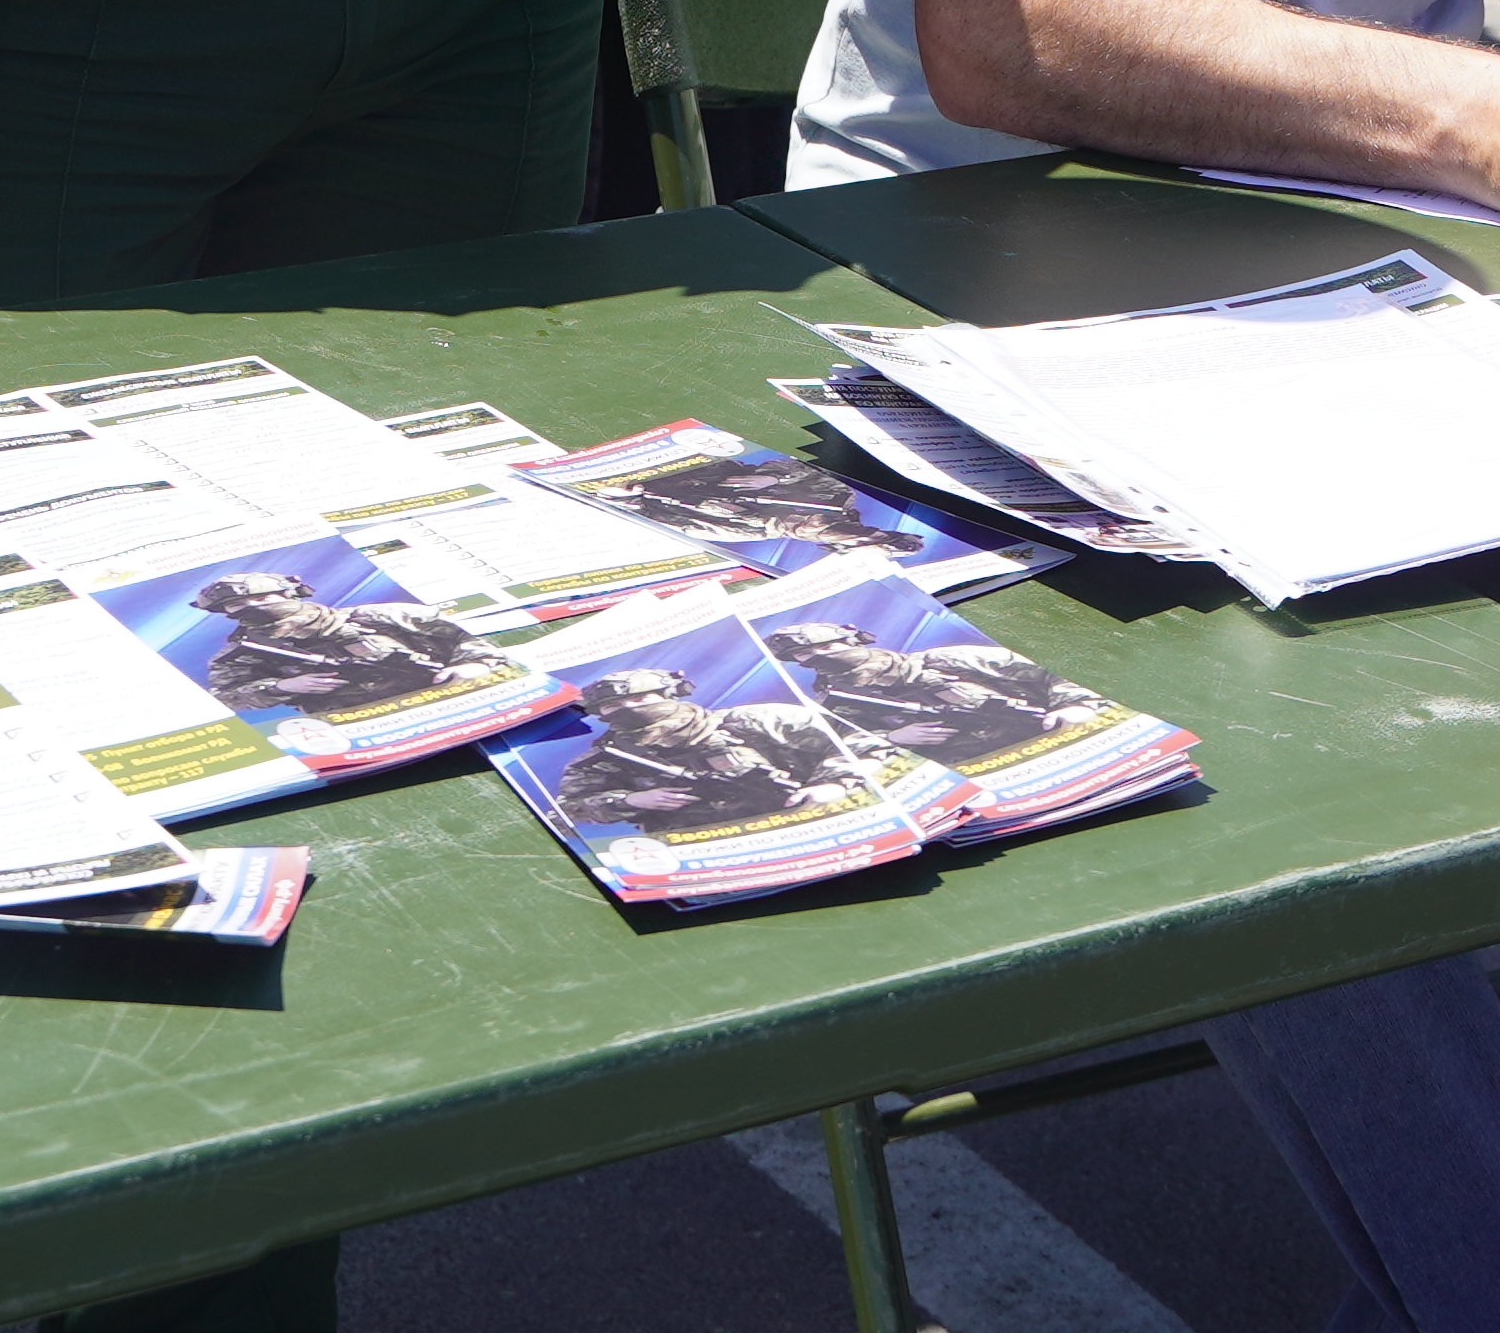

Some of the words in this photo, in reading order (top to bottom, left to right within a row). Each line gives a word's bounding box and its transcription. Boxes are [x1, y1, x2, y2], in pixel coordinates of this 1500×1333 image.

[327, 701, 399, 724] Звони
[956, 751, 1021, 775] Звони
[666, 823, 743, 844] Звони
[744, 806, 826, 832] сейчас
